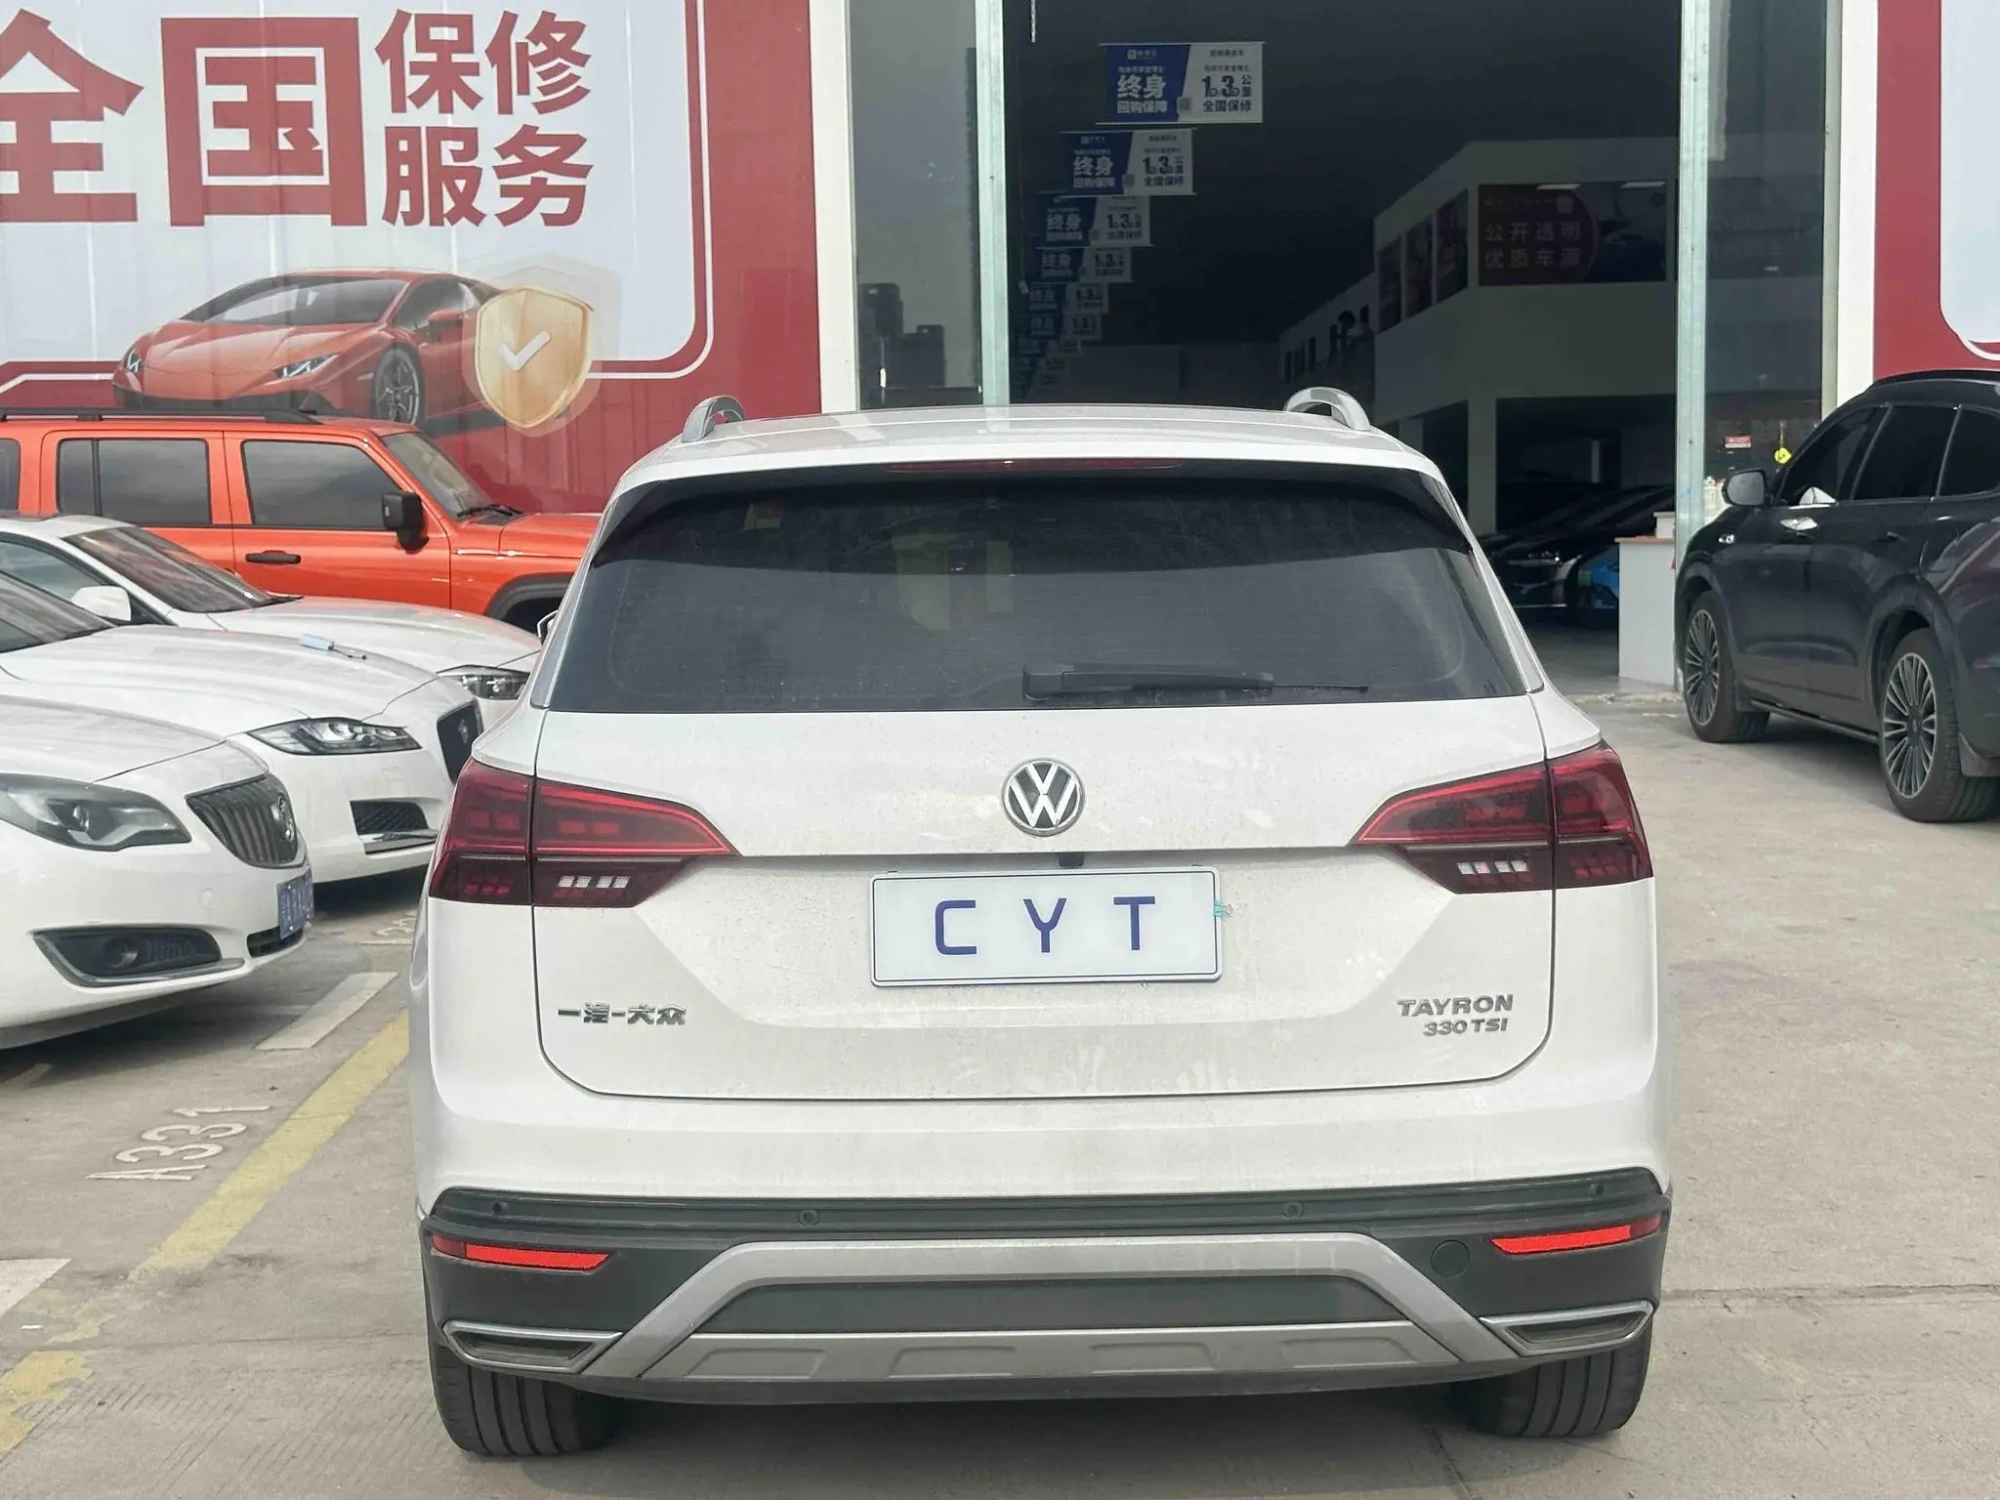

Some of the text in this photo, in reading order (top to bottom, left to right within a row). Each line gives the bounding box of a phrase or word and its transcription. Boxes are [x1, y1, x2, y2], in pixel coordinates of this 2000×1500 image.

[375, 8, 592, 116] 保修
[1117, 75, 1167, 98] 终身
[0, 8, 368, 227] 全国
[381, 124, 594, 227] 服务
[1397, 994, 1513, 1017] TAYRON
[1423, 1018, 1508, 1037] 330 TSI
